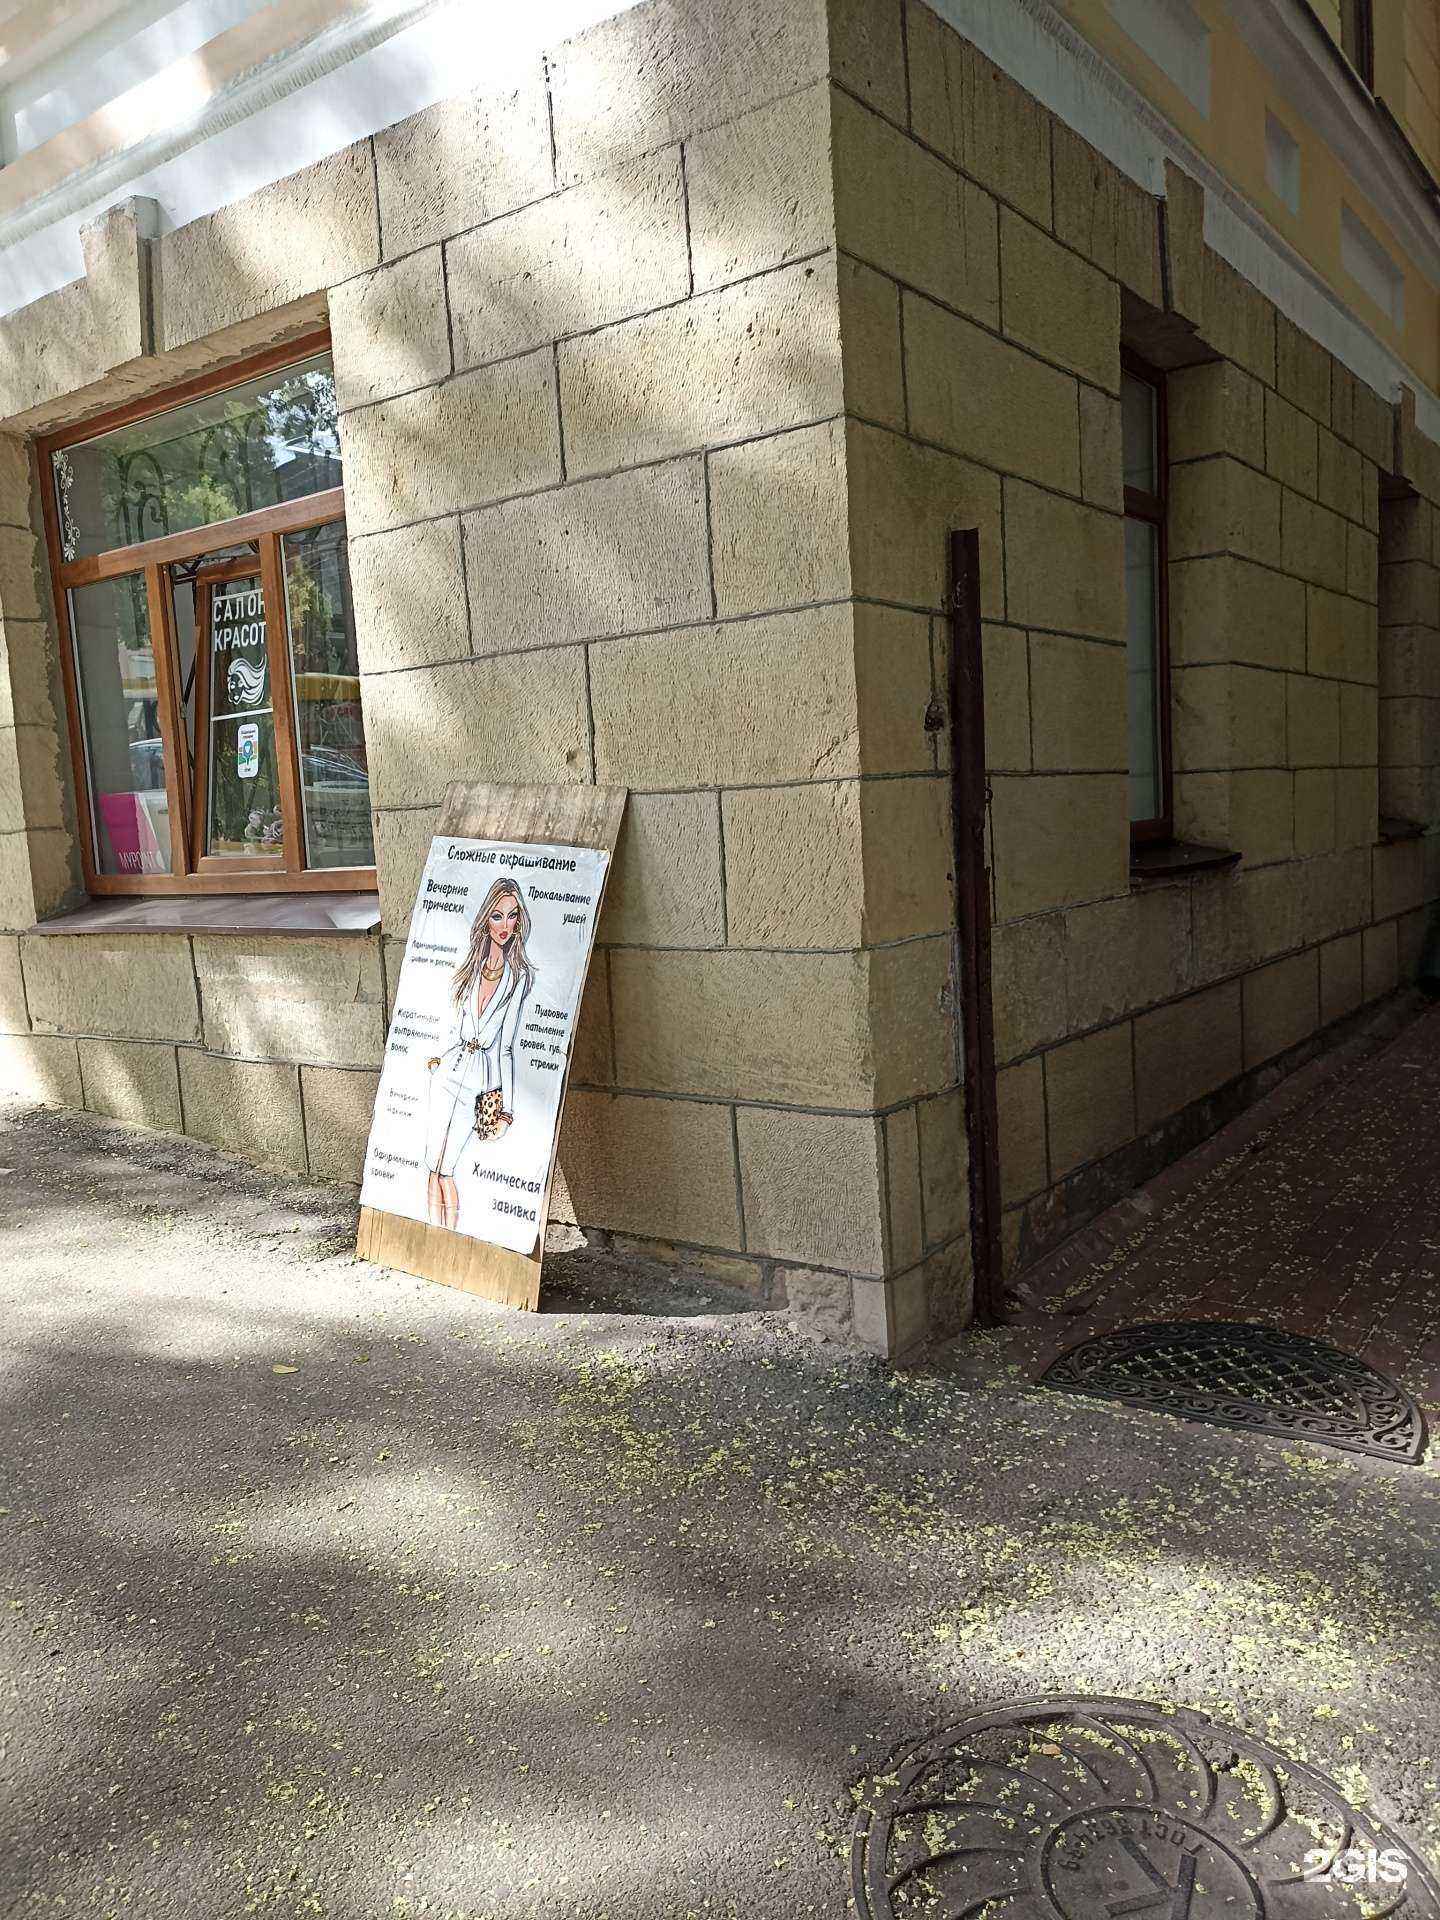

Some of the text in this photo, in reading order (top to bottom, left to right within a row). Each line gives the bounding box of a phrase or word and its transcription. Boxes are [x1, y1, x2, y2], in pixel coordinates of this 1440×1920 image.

[213, 592, 265, 622] САЛОН
[214, 621, 267, 652] КРАСОТ
[447, 845, 577, 872] Сложные окрашивание
[426, 879, 469, 897] Вечерние
[528, 886, 592, 905] Прокалывание
[422, 899, 465, 914] прически
[562, 913, 587, 926] ушей
[534, 1004, 569, 1021] Пудровое
[525, 1022, 566, 1038] напыление
[530, 1058, 560, 1072] стрелки
[472, 1161, 541, 1194] Химическая
[491, 1198, 537, 1223] завивка
